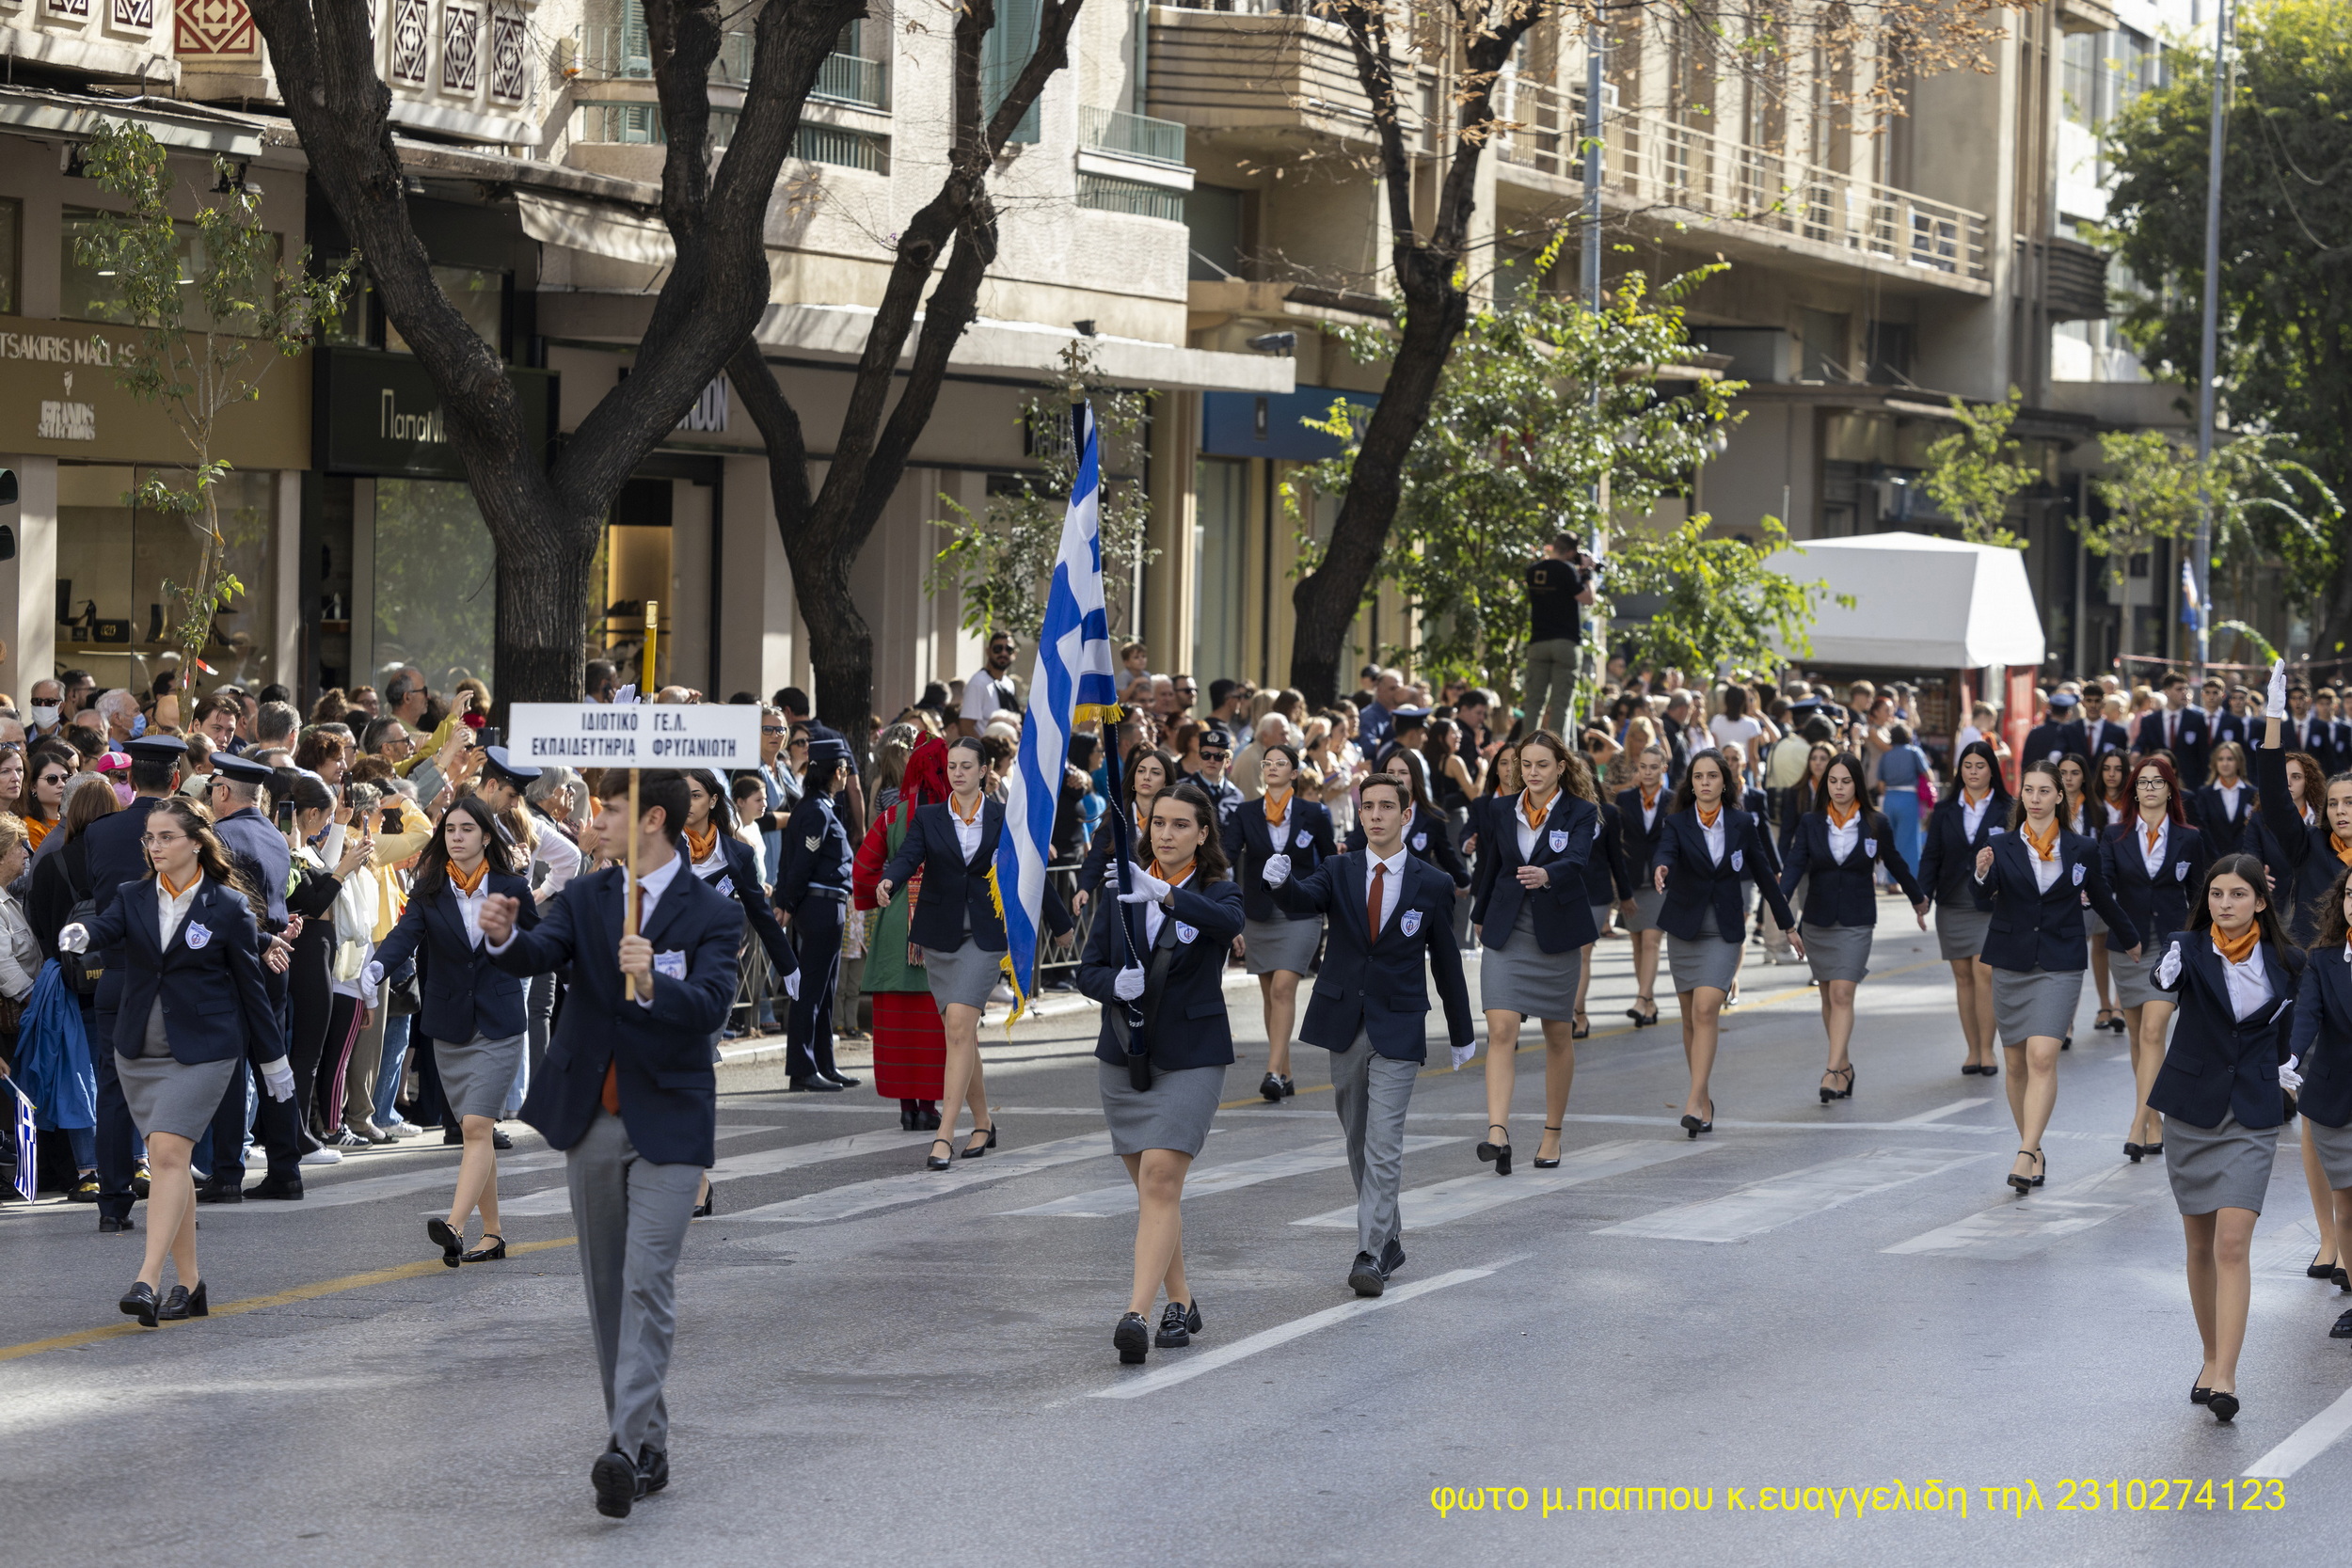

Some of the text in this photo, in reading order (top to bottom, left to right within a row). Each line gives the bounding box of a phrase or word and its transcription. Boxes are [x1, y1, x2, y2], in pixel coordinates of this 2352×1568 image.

[0, 332, 72, 364] TSAKIRIS
[532, 737, 736, 756] ΕΚΠΑΙΔΕΥΤΗΡΙΑ ΦΡΥΓΑΝΙΩΤΗ
